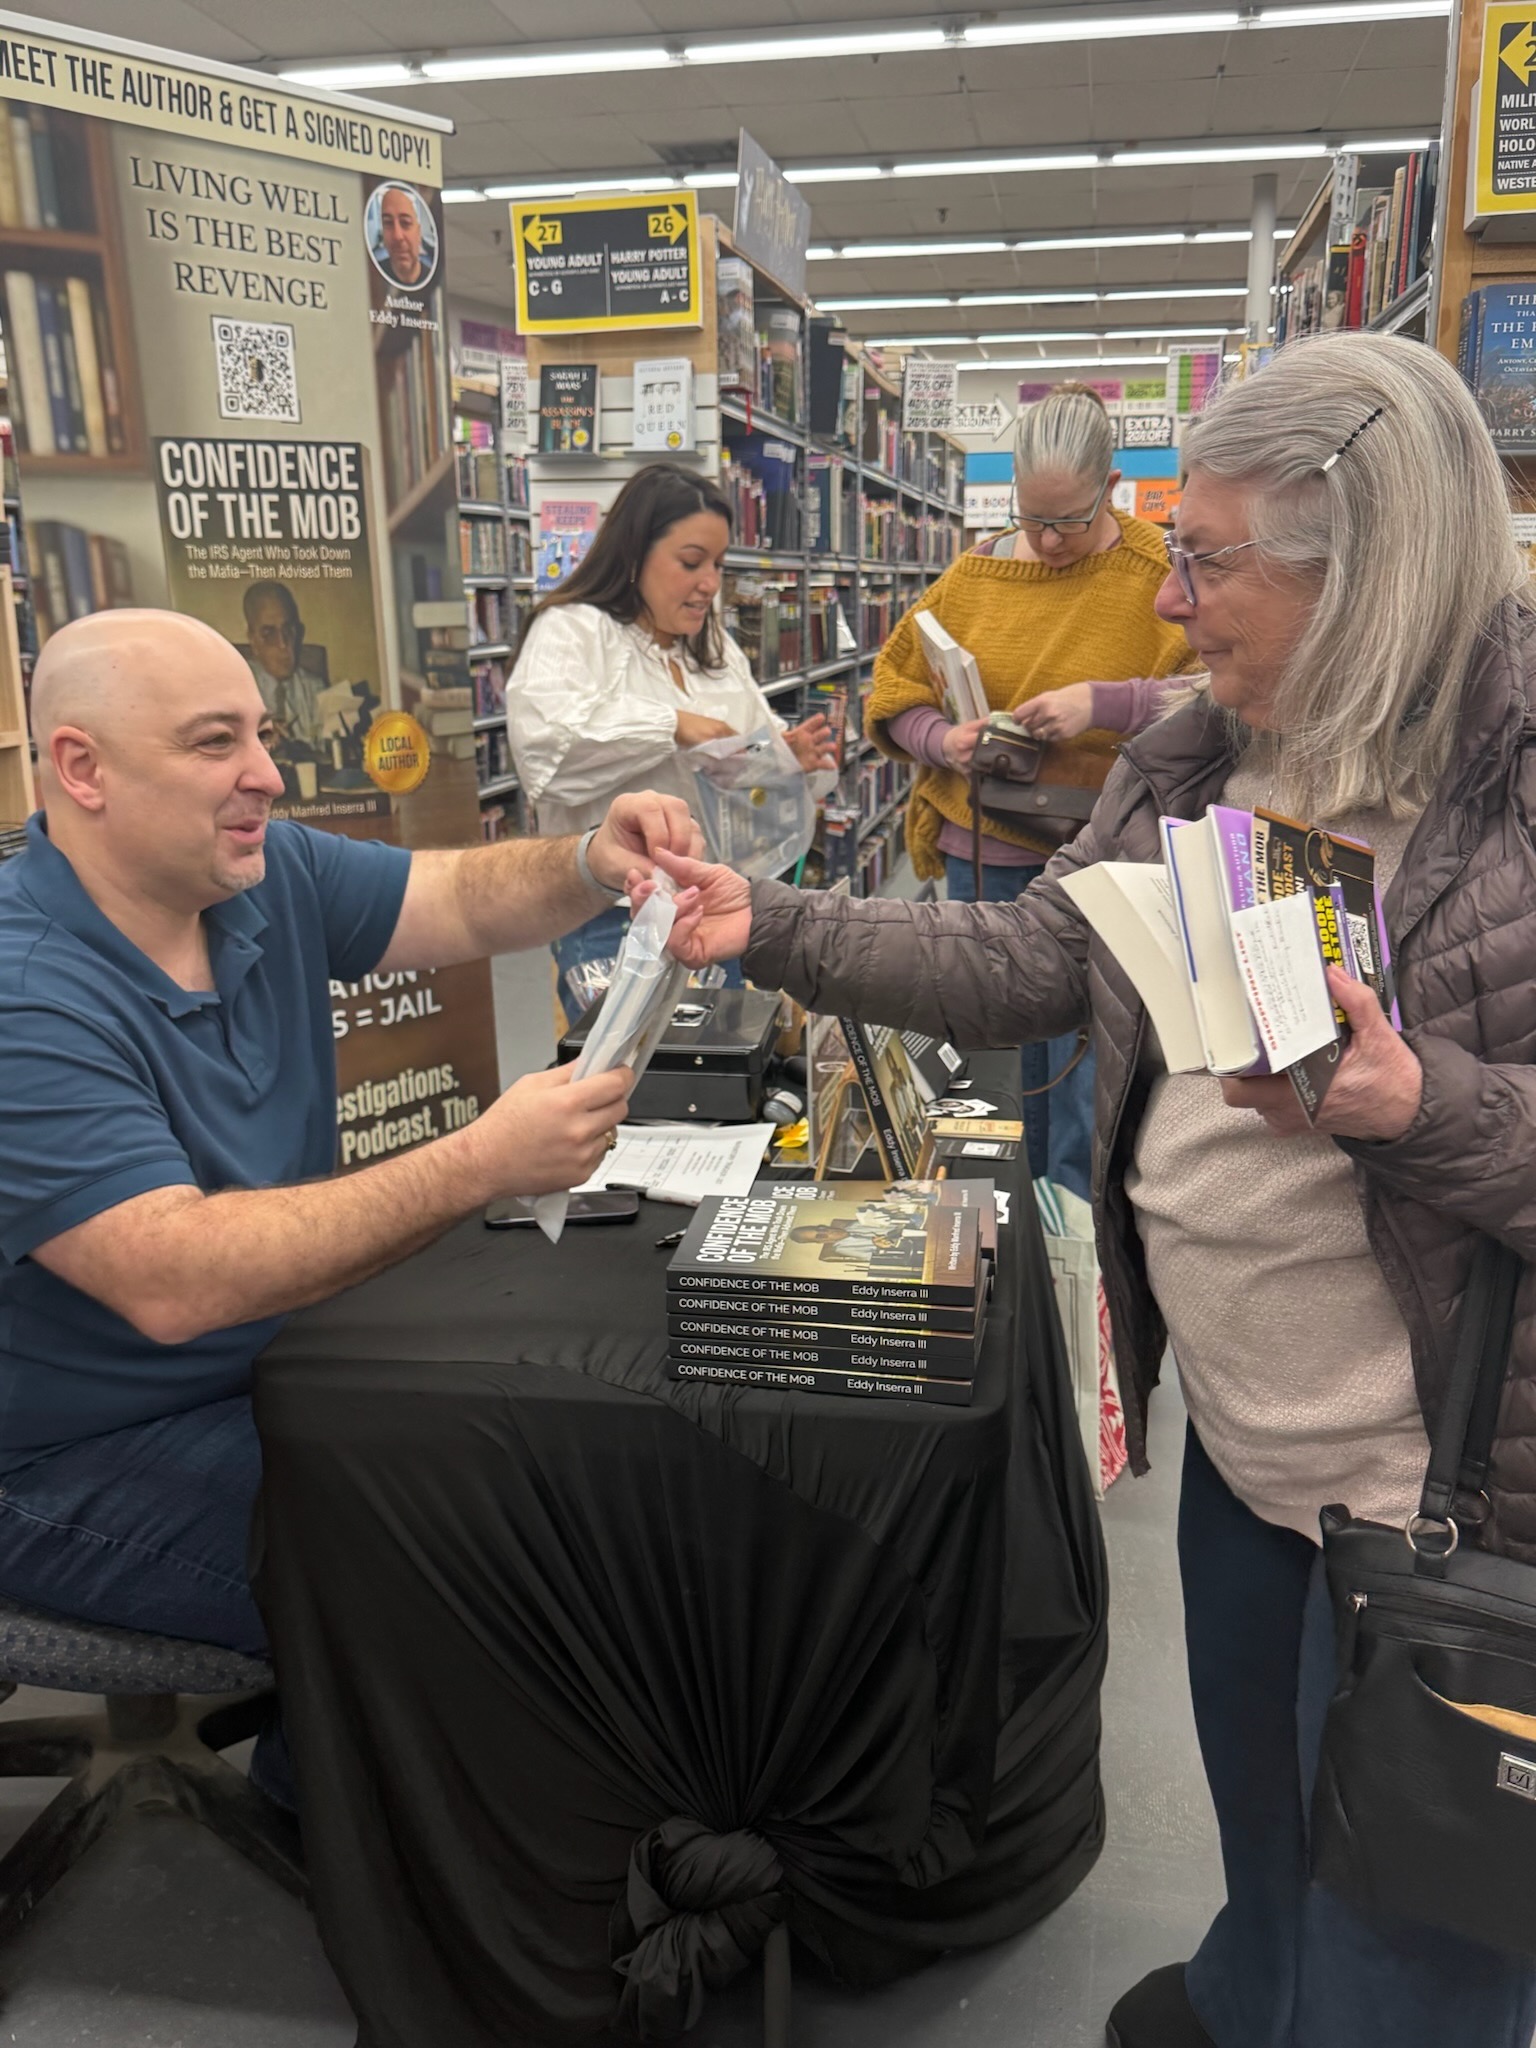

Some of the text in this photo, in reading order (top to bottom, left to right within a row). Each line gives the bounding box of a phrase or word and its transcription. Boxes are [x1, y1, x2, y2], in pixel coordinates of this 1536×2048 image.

[0, 40, 431, 169] MEET THE AUTHOR & GET A SIGNED COPY!
[1499, 118, 1536, 131] WORL
[1499, 138, 1536, 152] HOLO
[1497, 159, 1530, 170] NATIVE
[129, 156, 349, 224] LIVING WELL
[1497, 176, 1536, 190] WESTE
[536, 225, 558, 242] 27
[651, 216, 674, 233] 26
[146, 208, 342, 266] IS THE BEST
[527, 252, 604, 271] YOUNG ADULT
[610, 247, 687, 265] HARRY POTTER
[611, 269, 650, 284] YOUNG
[652, 266, 688, 281] ADULT
[173, 261, 328, 310] REVENGE
[528, 278, 563, 296] C G
[384, 295, 424, 312] Author
[660, 289, 689, 303] A C
[369, 309, 439, 331] Eddy Inserra
[1491, 321, 1525, 333] THE
[1511, 338, 1533, 349] EM
[932, 380, 953, 391] OFF
[647, 403, 675, 415] RED
[931, 399, 953, 410] OFF
[635, 420, 687, 434] QUEEN
[930, 417, 952, 428] OFF
[1124, 417, 1171, 430] EXTRA
[160, 441, 359, 491] CONFIDENCE
[167, 491, 361, 540] OF THE MOB
[185, 544, 351, 563] The IRS Agent Who Took Down
[187, 564, 207, 578] the
[278, 563, 320, 578] Advised
[322, 564, 352, 578] Them
[380, 736, 414, 752] LOCAL
[378, 753, 419, 771] AUTHOR
[290, 803, 331, 818] Manfred
[332, 800, 366, 815] Inserra
[1255, 830, 1265, 864] MOB
[1313, 896, 1333, 958] BOOK
[355, 1008, 373, 1028] =
[380, 987, 442, 1027] JAIL
[867, 1084, 881, 1107] MOB
[883, 1128, 896, 1151] Eddy
[340, 1094, 479, 1165] Podcast, The
[696, 1197, 750, 1262] CONFIDENCE
[726, 1199, 777, 1263] OF THE MOB
[679, 1276, 819, 1293] CONFIDENCE OF THE MOB
[852, 1285, 928, 1299] Eddy Inserra III
[678, 1298, 818, 1316] CONFIDENCE OF THE MOB
[851, 1308, 927, 1322] Eddy Inserra III
[680, 1321, 819, 1341] CONFIDENCE OF THE MOB
[850, 1333, 927, 1349] Eddy Inserra III
[680, 1344, 819, 1362] CONFIDENCE OF THE MOB
[851, 1355, 927, 1369] Eddy Inserra III
[677, 1365, 816, 1386] CONFIDENCE OF THE MOB
[847, 1378, 923, 1394] Eddy Inserra III
